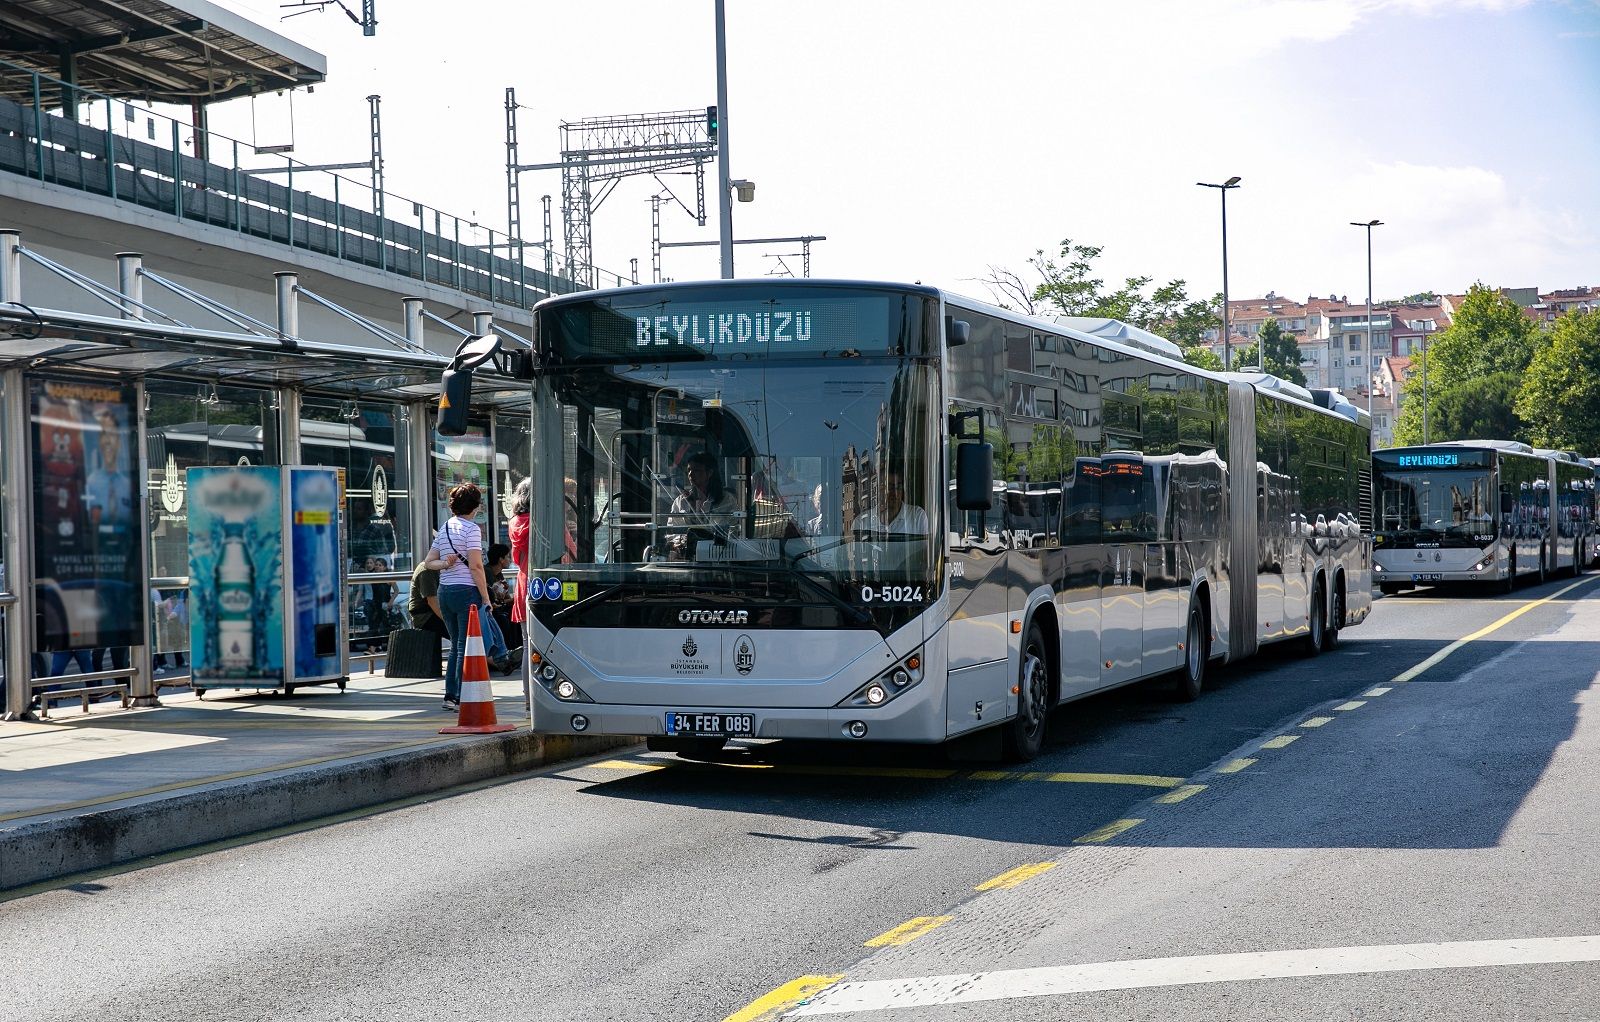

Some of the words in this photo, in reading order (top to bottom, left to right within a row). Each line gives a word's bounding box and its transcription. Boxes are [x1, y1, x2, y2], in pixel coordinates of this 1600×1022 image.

[637, 311, 811, 346] BEYLİKDÜZÜ
[678, 609, 749, 624] OTOKAR
[675, 715, 691, 731] 34
[695, 715, 720, 732] FER
[725, 716, 751, 732] 089
